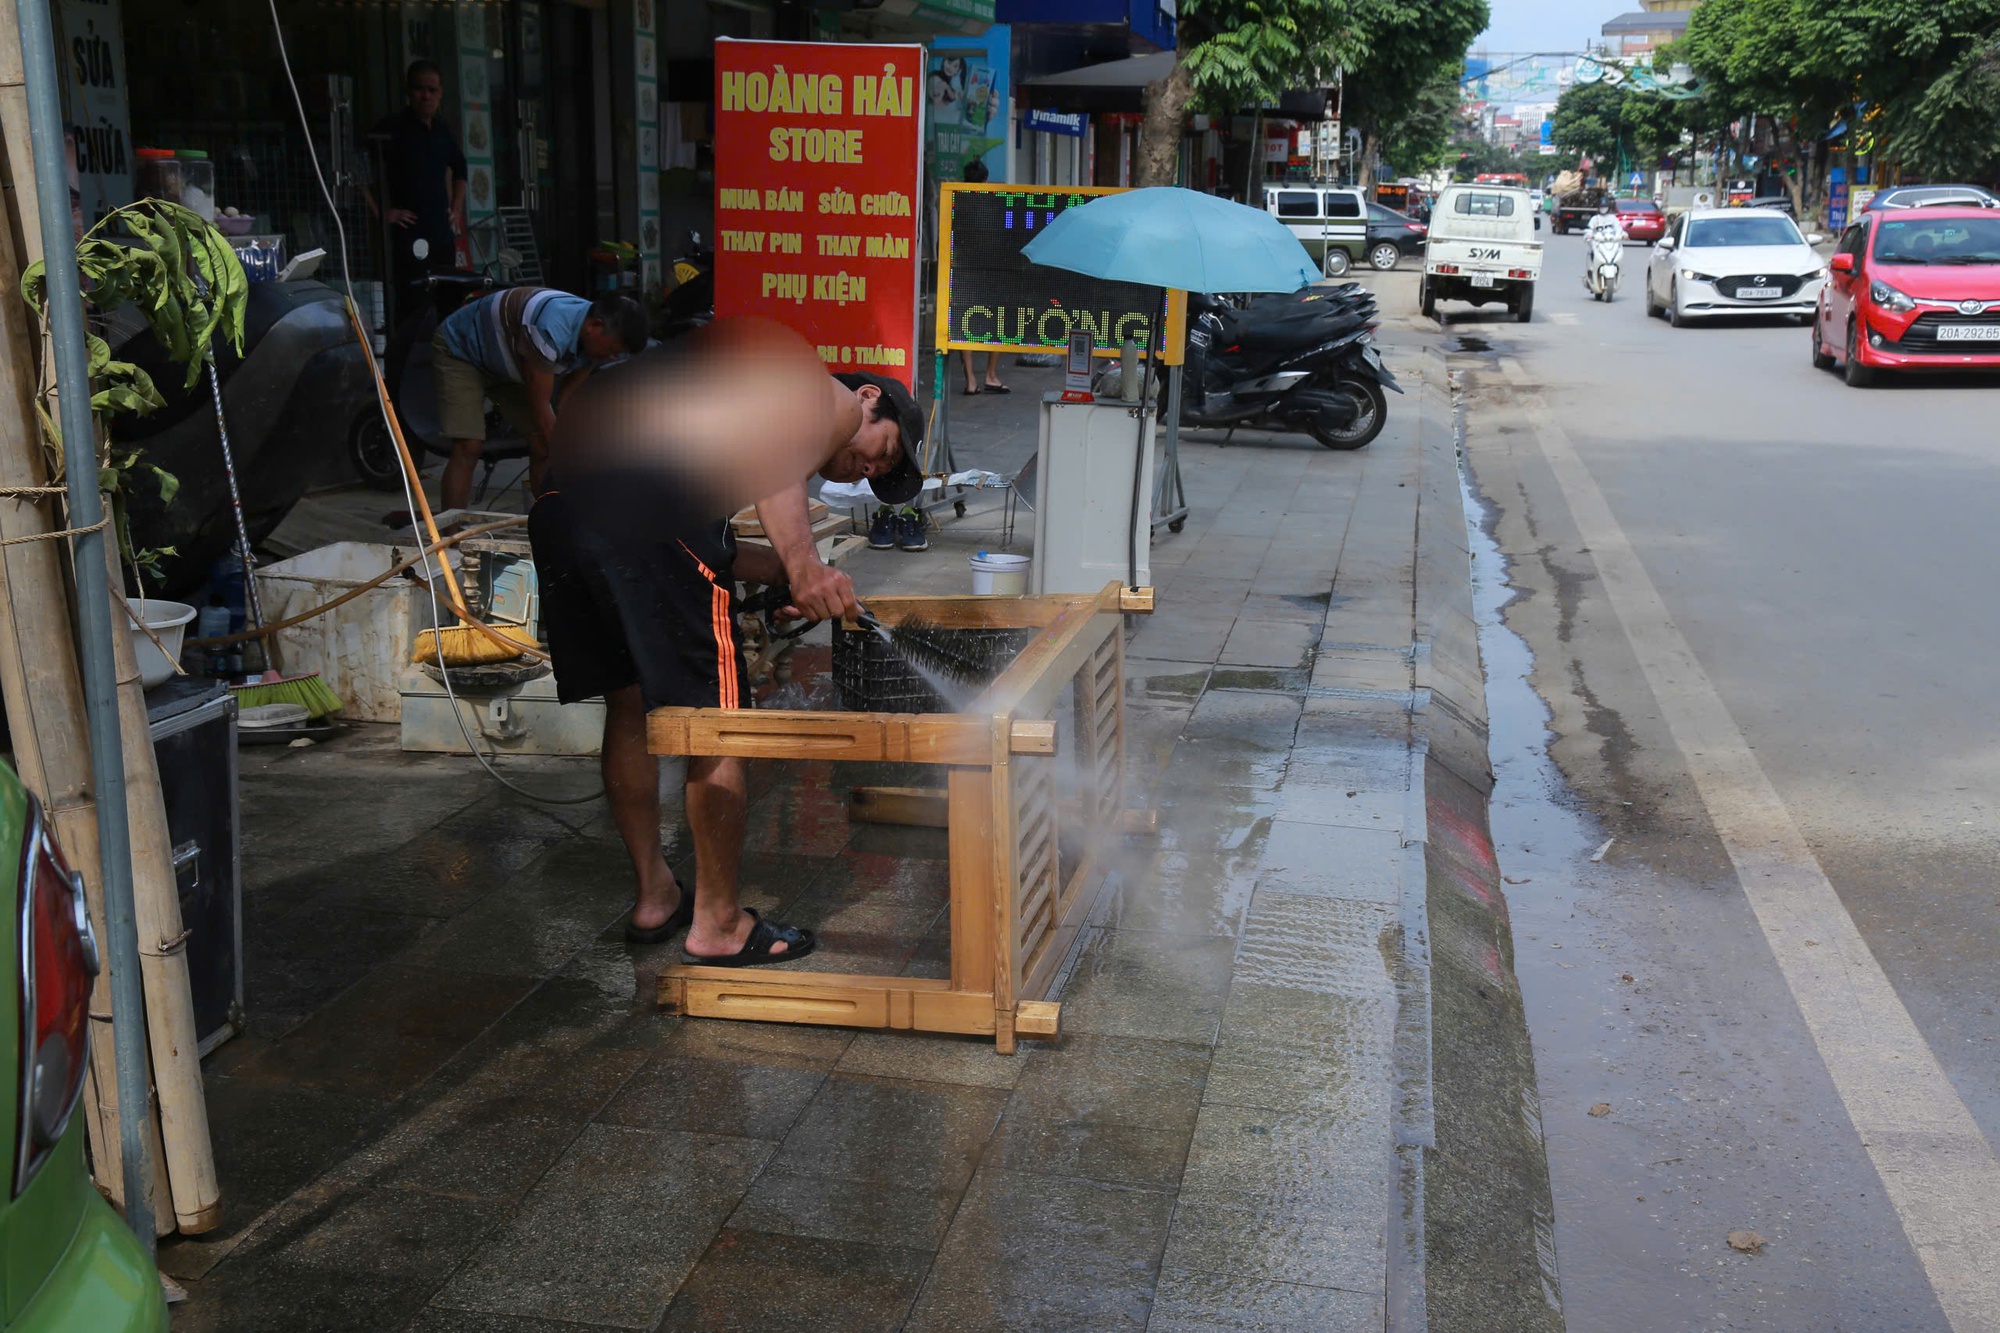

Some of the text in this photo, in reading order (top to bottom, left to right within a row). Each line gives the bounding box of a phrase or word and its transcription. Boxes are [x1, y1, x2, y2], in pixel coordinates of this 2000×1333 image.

[72, 19, 116, 89] SỬA
[721, 62, 913, 117] HOÀNG HẢI
[1032, 109, 1081, 126] Vinamilk
[769, 127, 863, 164] STORE
[720, 186, 912, 217] MUA BÁN SỬA CHỮA
[721, 230, 910, 258] THAY PIN THAY MÀN
[1468, 247, 1501, 260] SYM
[762, 271, 867, 306] PHỤ KIỆN
[855, 344, 906, 367] THÁNG
